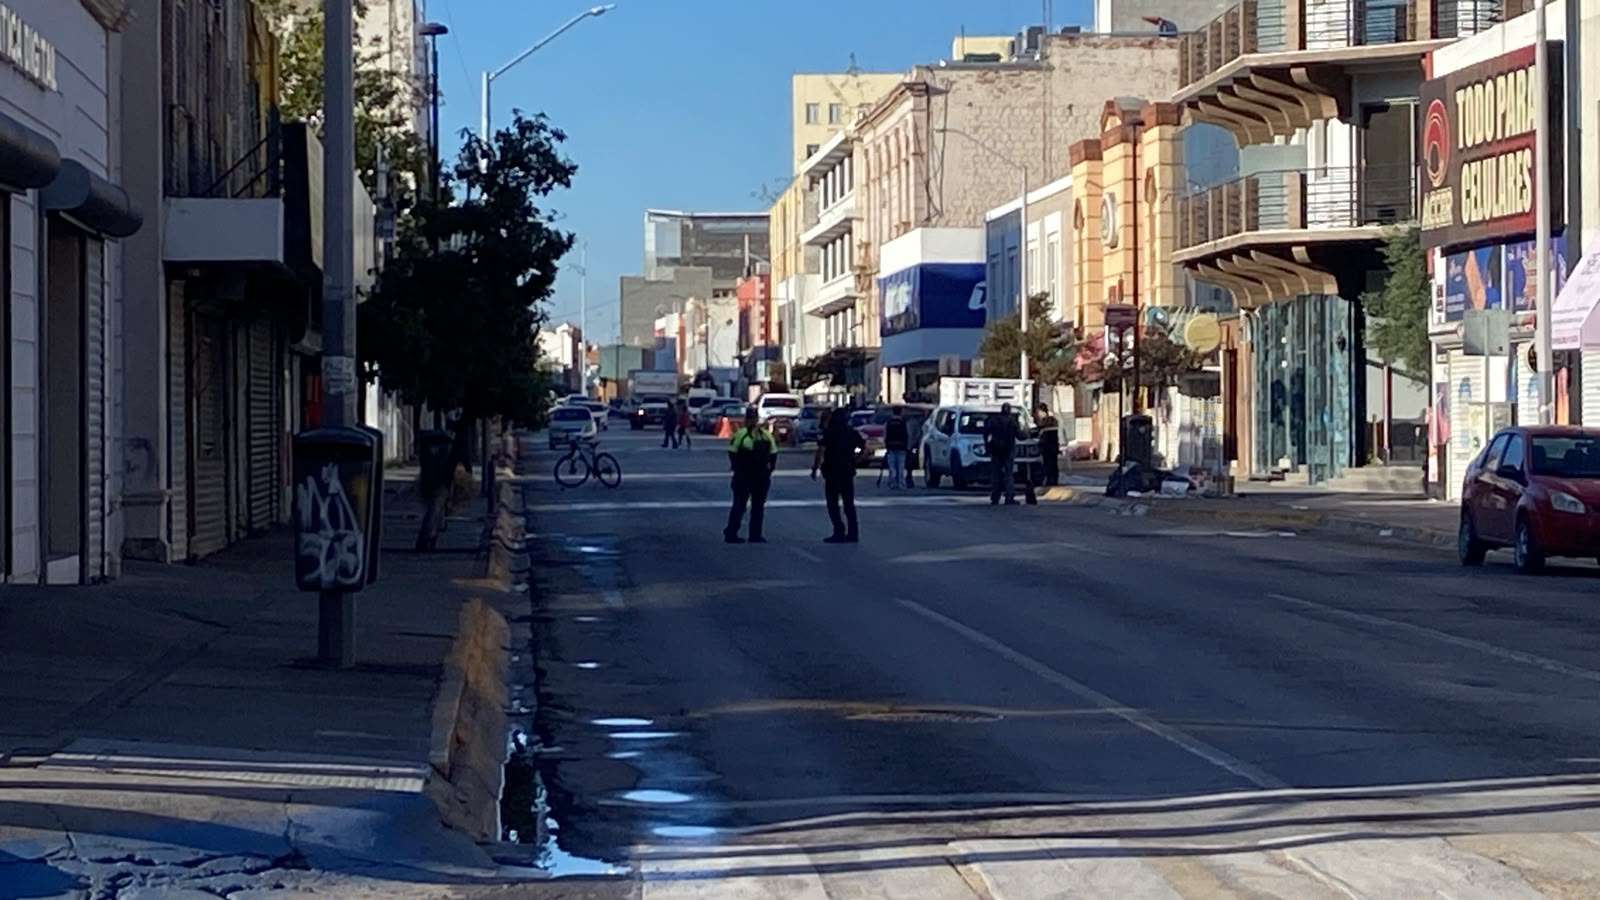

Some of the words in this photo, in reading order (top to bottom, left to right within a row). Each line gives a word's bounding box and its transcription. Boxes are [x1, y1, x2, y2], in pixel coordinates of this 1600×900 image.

[1456, 79, 1494, 149] TODO
[1496, 65, 1536, 139] PARA
[1461, 149, 1531, 225] CELULARES
